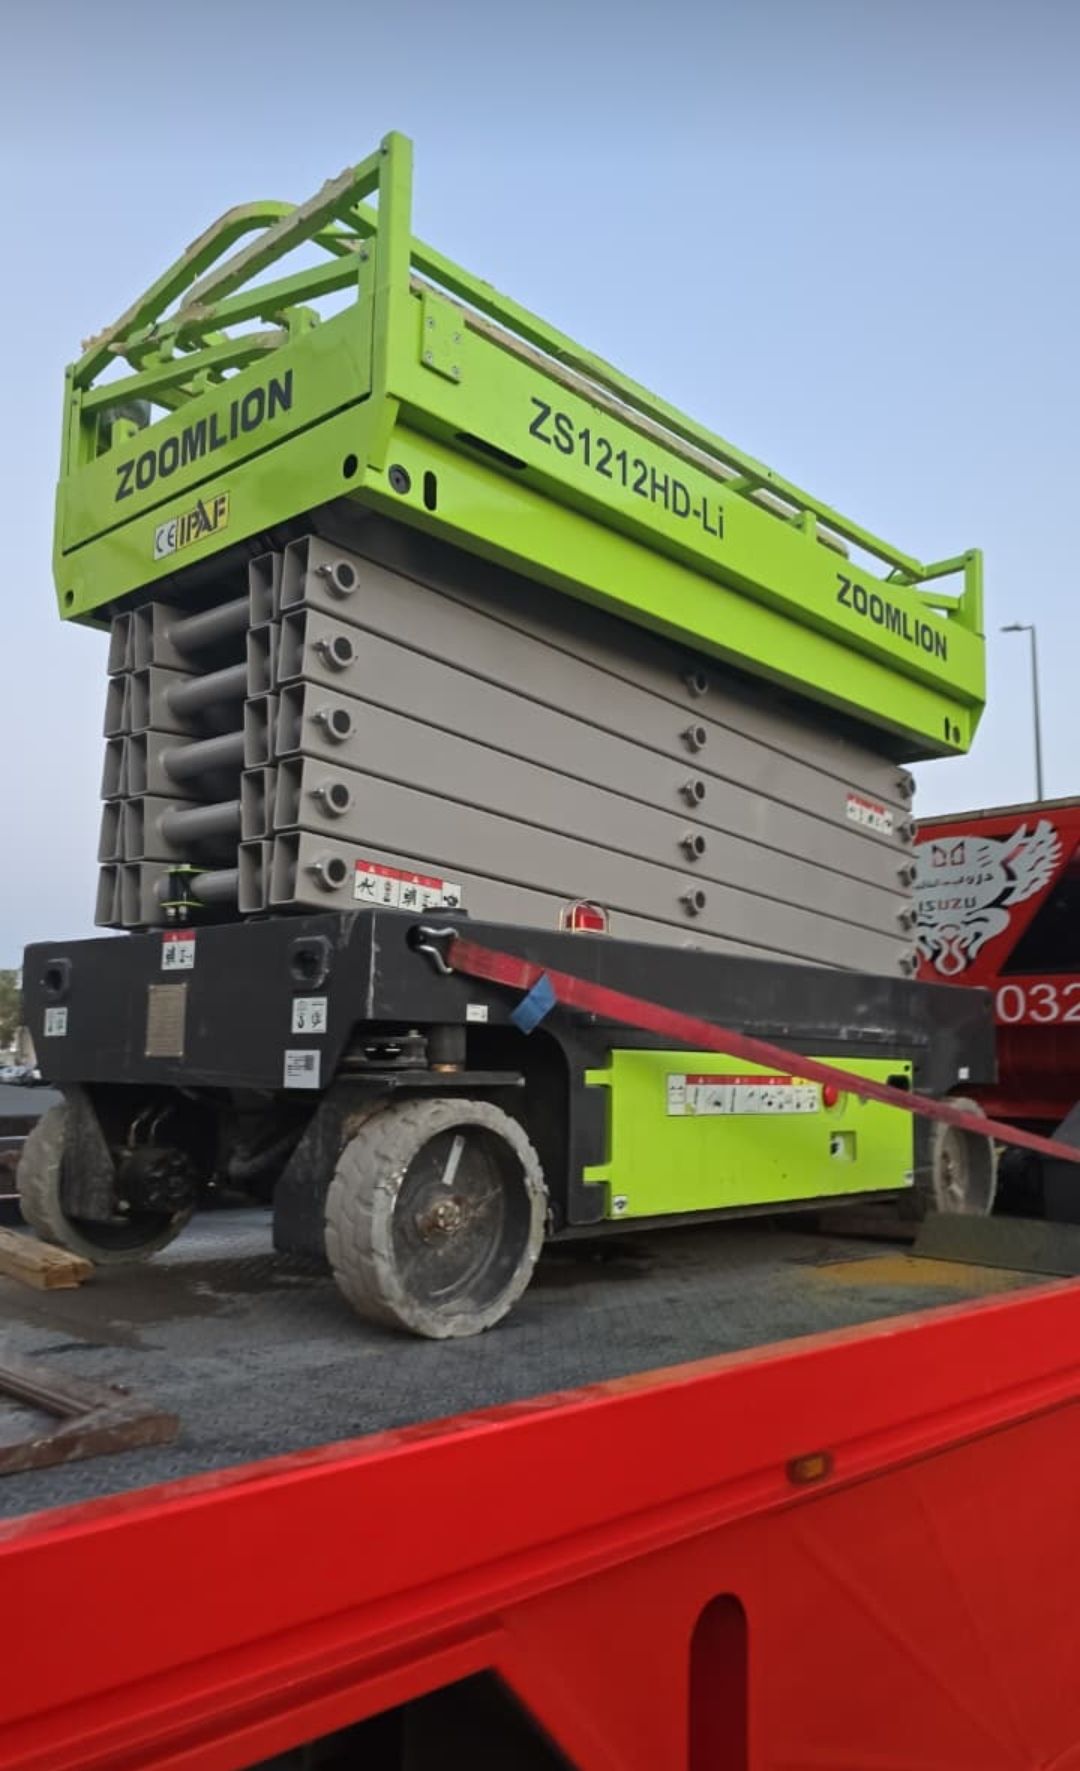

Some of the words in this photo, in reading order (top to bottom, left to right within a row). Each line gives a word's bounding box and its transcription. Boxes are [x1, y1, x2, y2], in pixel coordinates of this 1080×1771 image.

[115, 368, 293, 502] ZOOMLION
[529, 397, 724, 539] ZS1212HD-Li
[180, 496, 226, 546] IPAF
[836, 573, 948, 662] ZOOMLION
[918, 896, 977, 912] ISUZU
